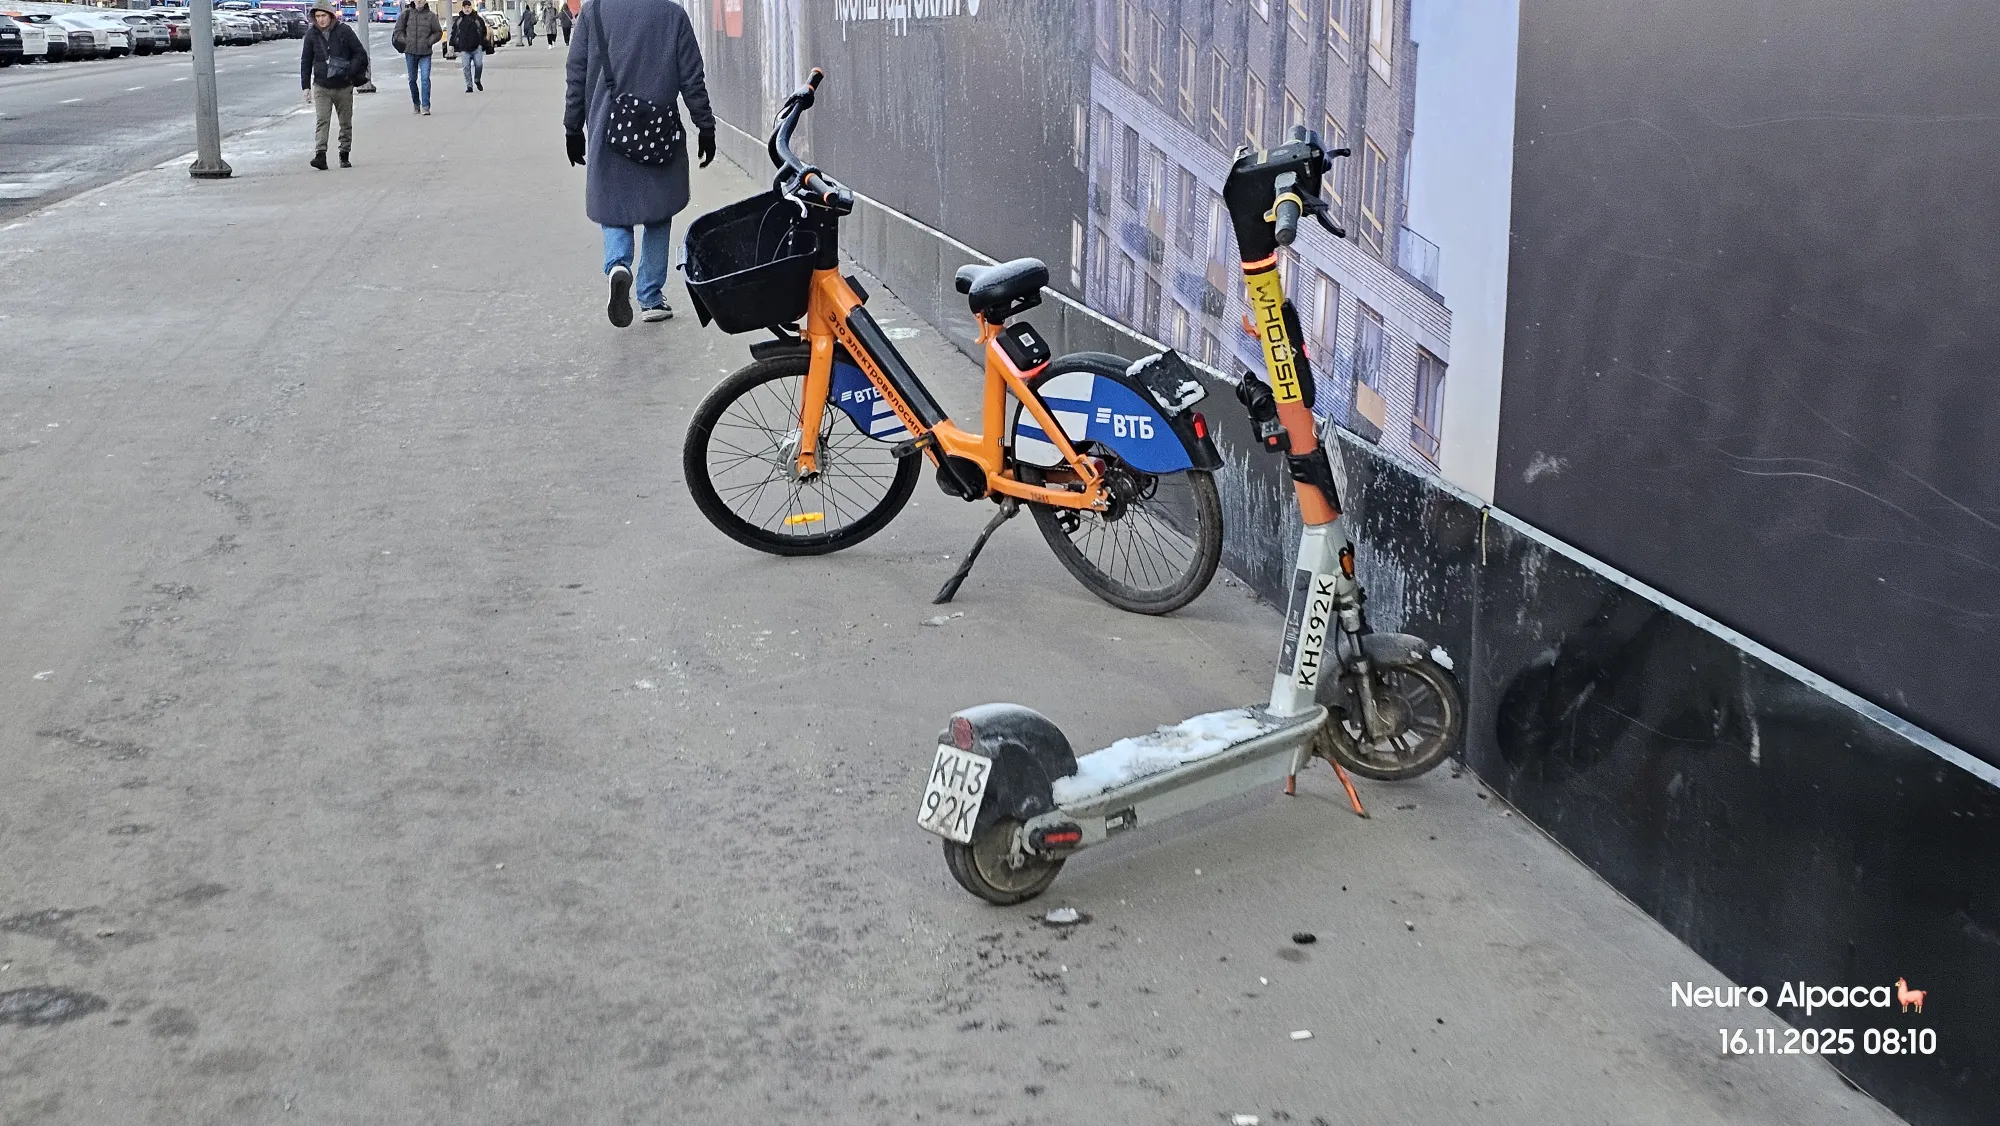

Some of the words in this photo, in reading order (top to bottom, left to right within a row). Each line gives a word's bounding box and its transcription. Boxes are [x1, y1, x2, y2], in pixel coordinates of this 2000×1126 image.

[828, 311, 856, 336] Это
[846, 336, 929, 449] электровелосип
[1256, 281, 1297, 400] WHOOSH
[1113, 413, 1155, 440] ВТБ
[1298, 579, 1334, 686] КН392К
